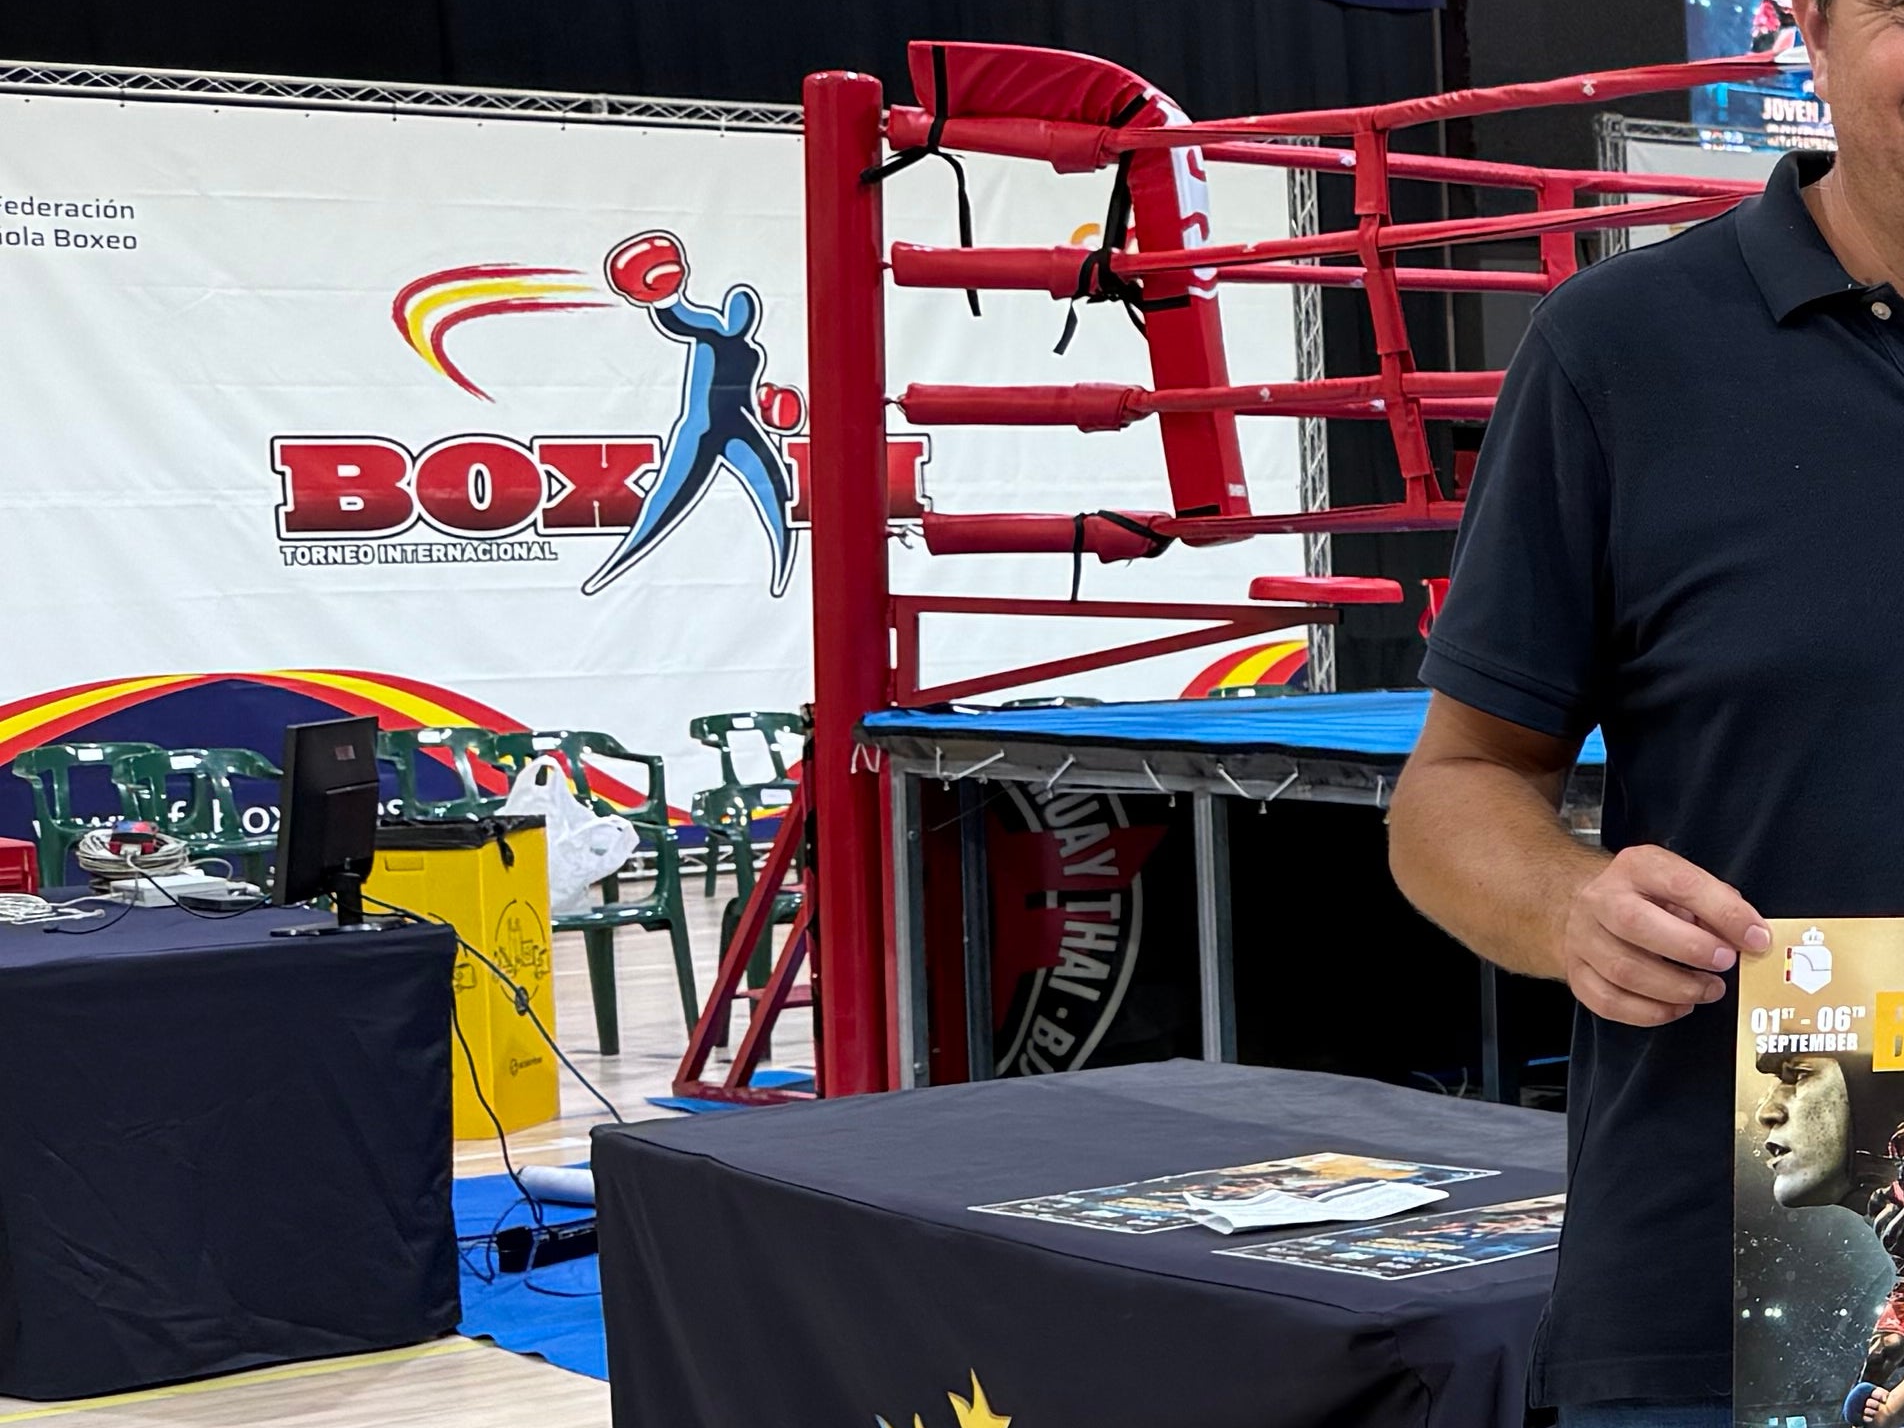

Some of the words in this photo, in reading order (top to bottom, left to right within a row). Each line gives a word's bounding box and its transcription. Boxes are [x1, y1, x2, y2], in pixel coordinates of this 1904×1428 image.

[54, 228, 137, 250] Boxeo
[281, 543, 374, 566] TORNEO
[377, 542, 558, 564] INTERNACIONAL
[1048, 892, 1122, 1002] THAI
[1756, 1031, 1858, 1054] SEPTEMBER
